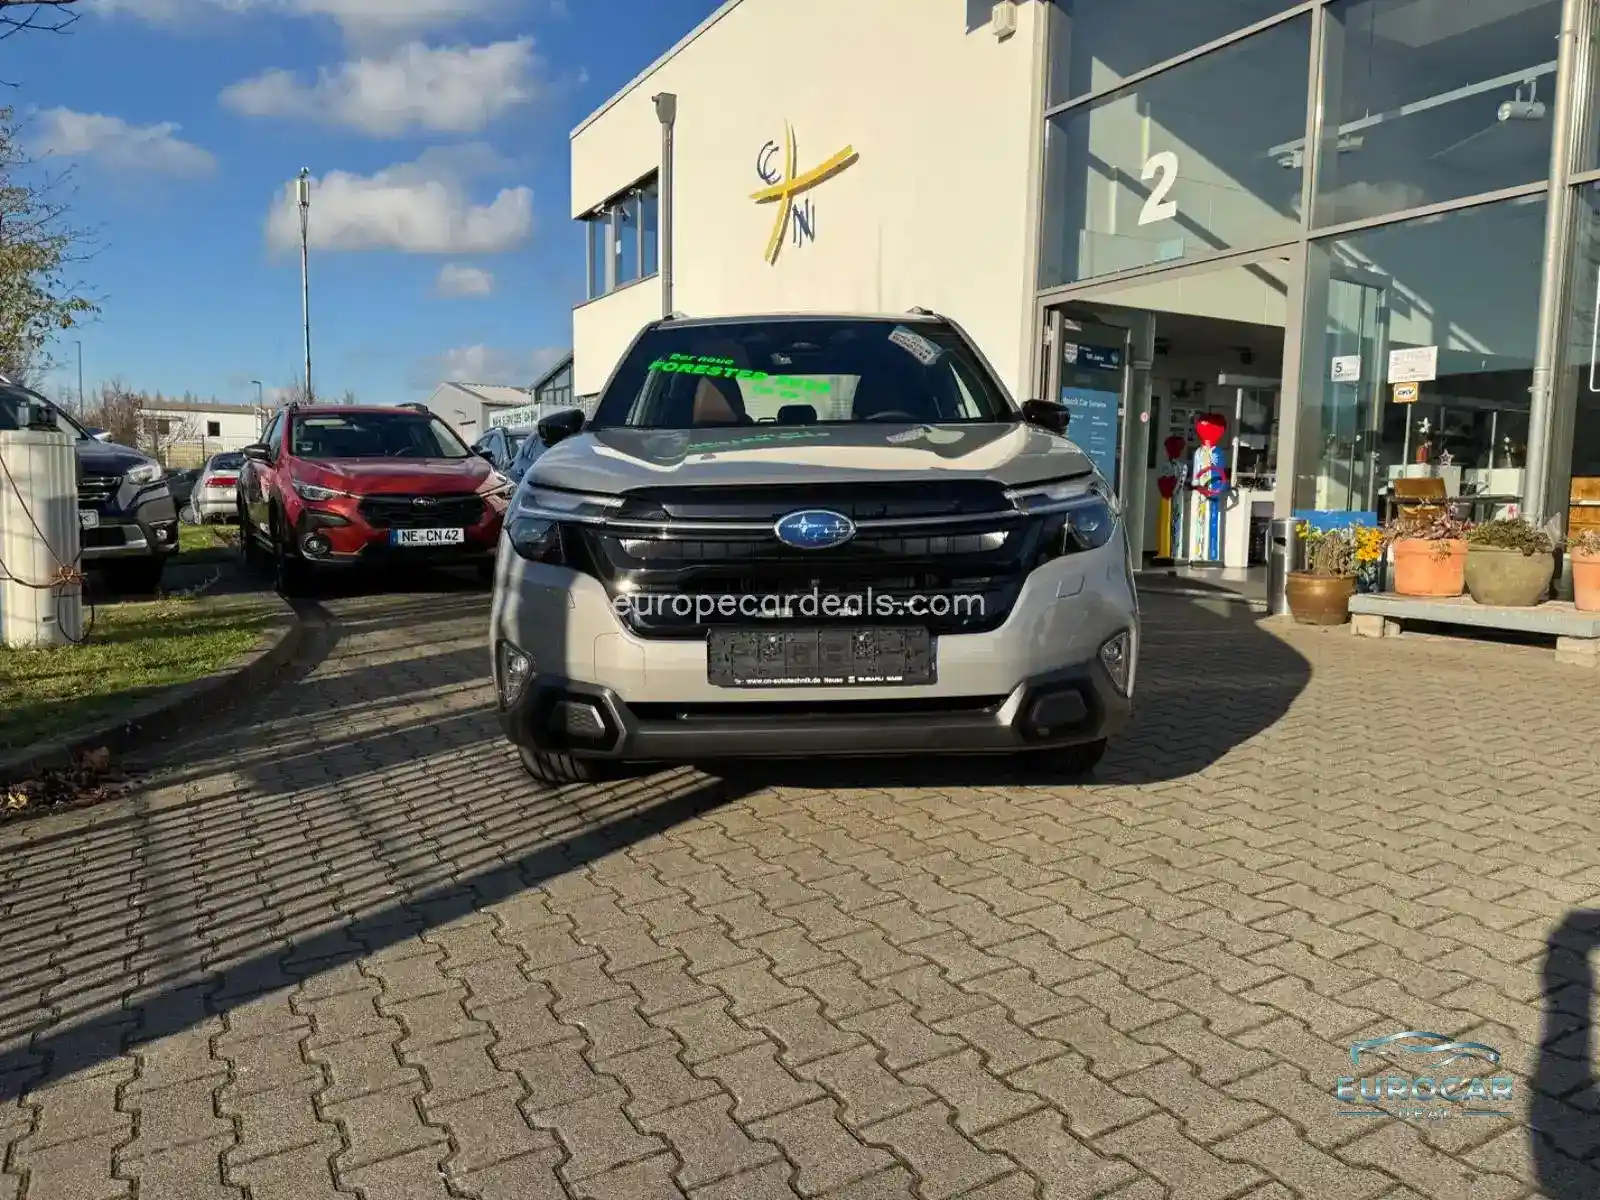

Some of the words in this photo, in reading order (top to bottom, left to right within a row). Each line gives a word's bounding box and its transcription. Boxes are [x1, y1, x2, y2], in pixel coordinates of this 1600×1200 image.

[1138, 151, 1179, 225] 2
[402, 530, 418, 542] NE
[426, 530, 442, 541] CN
[444, 529, 459, 541] 42
